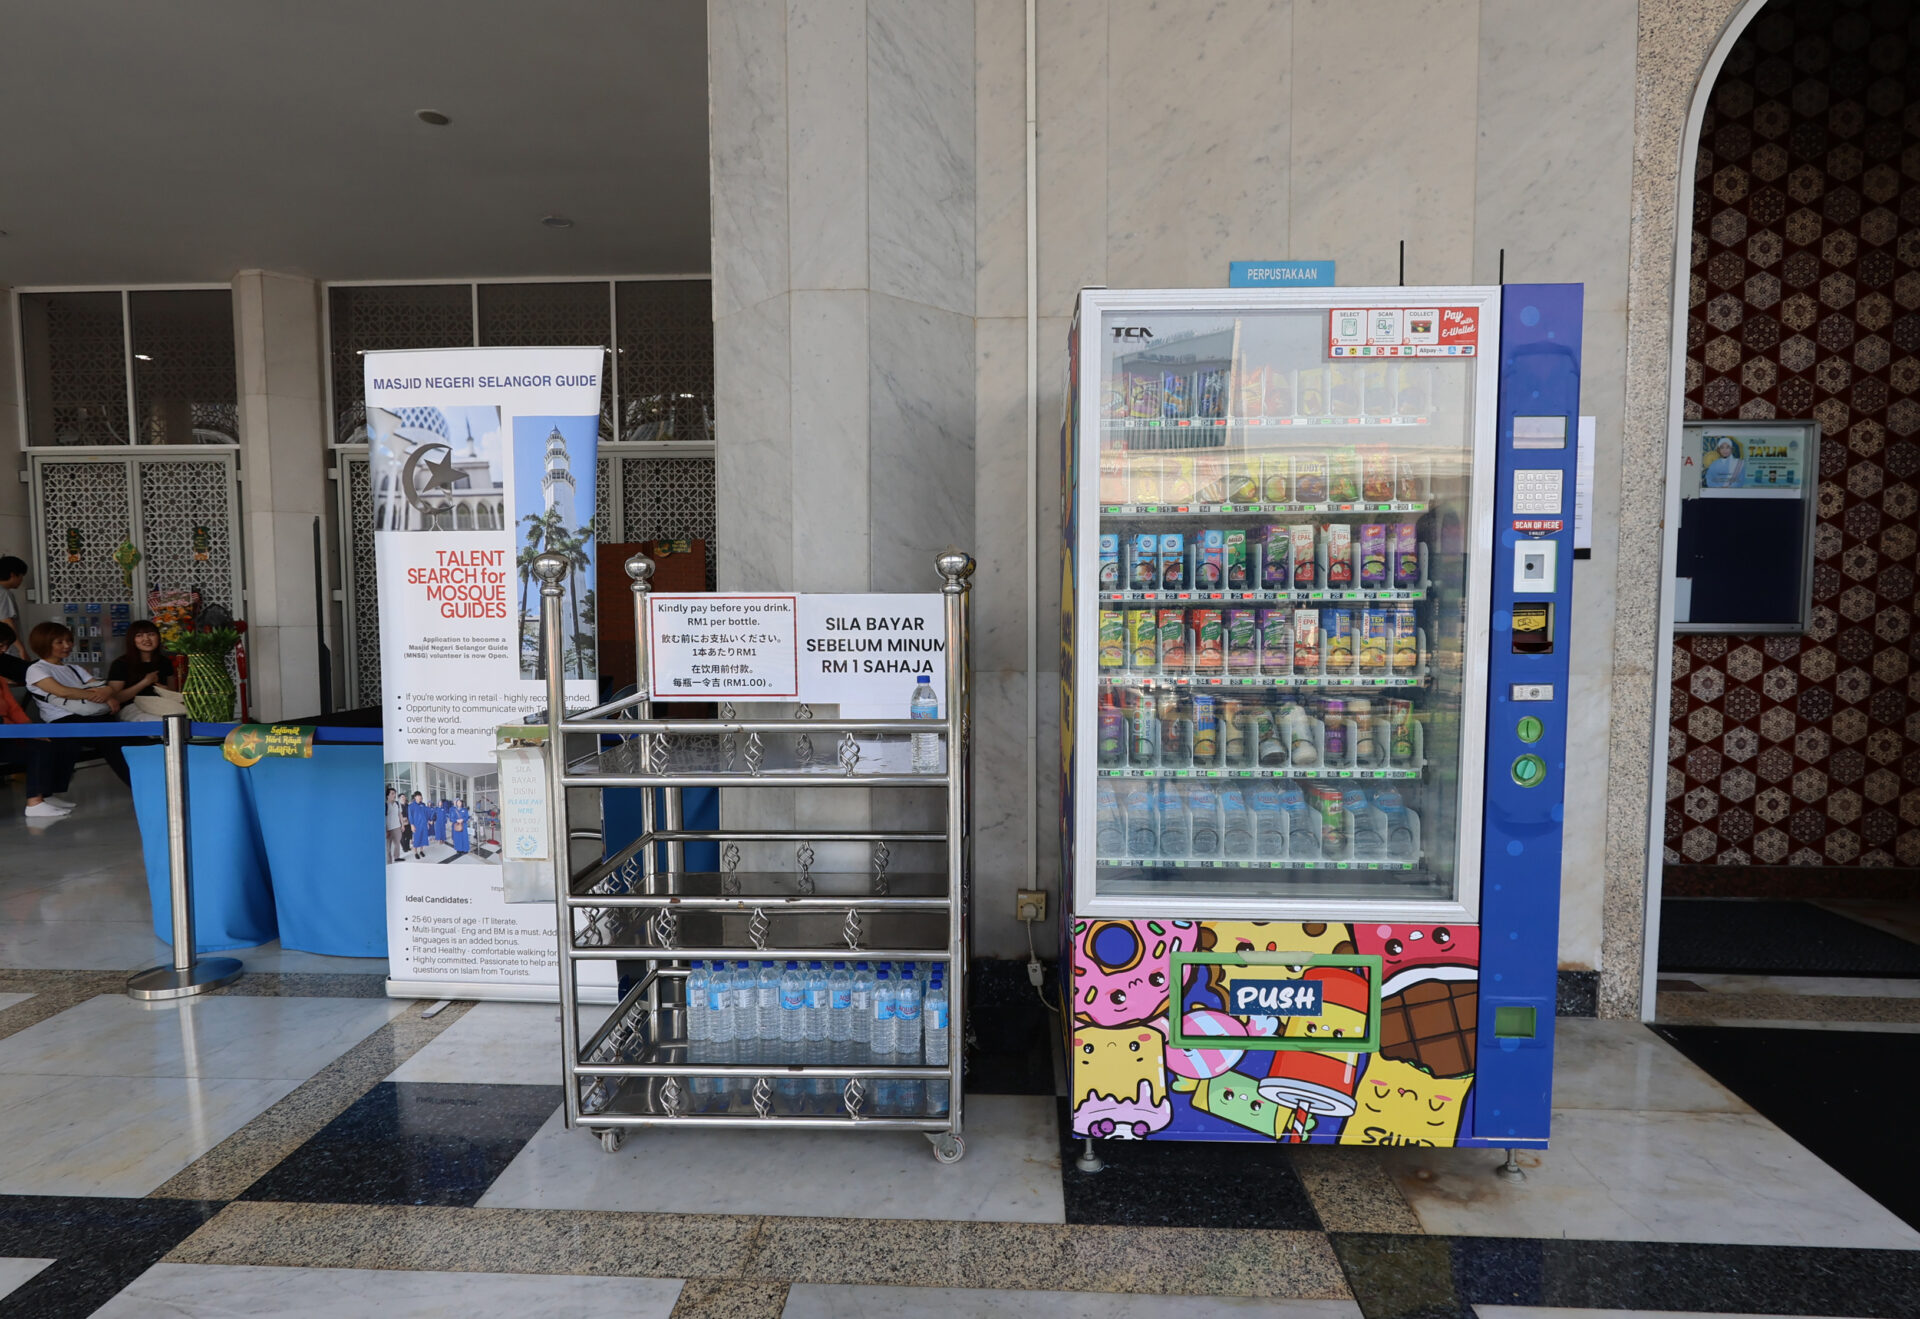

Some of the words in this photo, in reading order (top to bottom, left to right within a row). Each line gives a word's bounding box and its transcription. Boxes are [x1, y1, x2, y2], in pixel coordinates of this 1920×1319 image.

[1247, 268, 1318, 280] PERPUSTAKAAN
[1444, 310, 1464, 322] Pay
[373, 377, 422, 390] MASJID
[425, 376, 475, 389] NEGERI
[478, 375, 552, 388] SELANGOR
[555, 374, 597, 387] GUIDE
[436, 550, 505, 567] TALENT
[408, 568, 477, 584] SEARCH
[481, 568, 506, 584] for
[426, 585, 506, 605] MOSQUE
[440, 602, 507, 618] GUIDES
[658, 604, 688, 614] Kindly
[690, 605, 708, 614] pay
[710, 604, 742, 612] before
[744, 605, 761, 613] you
[764, 604, 791, 612] drink.
[688, 618, 708, 626] RM1
[710, 619, 726, 627] per
[728, 618, 760, 626] bottle.
[826, 617, 862, 631] SILA
[866, 617, 924, 631] BAYAR
[806, 638, 882, 652] SEBELUM
[822, 659, 848, 673] RM
[852, 659, 858, 673] 1
[863, 659, 934, 673] SAHAJA
[724, 678, 766, 688] (RM1.00)
[412, 693, 434, 702] you're
[436, 694, 467, 703] working
[504, 693, 528, 703] highly
[406, 704, 450, 714] Opportunity
[407, 727, 436, 735] Looking
[425, 896, 469, 904] Candidates
[412, 926, 456, 935] Multi-lingual
[461, 928, 476, 936] Eng
[412, 936, 450, 944] languages
[438, 947, 466, 955] Healthy
[413, 956, 436, 964] Highly
[530, 959, 546, 967] help
[1236, 986, 1316, 1010] PUSH
